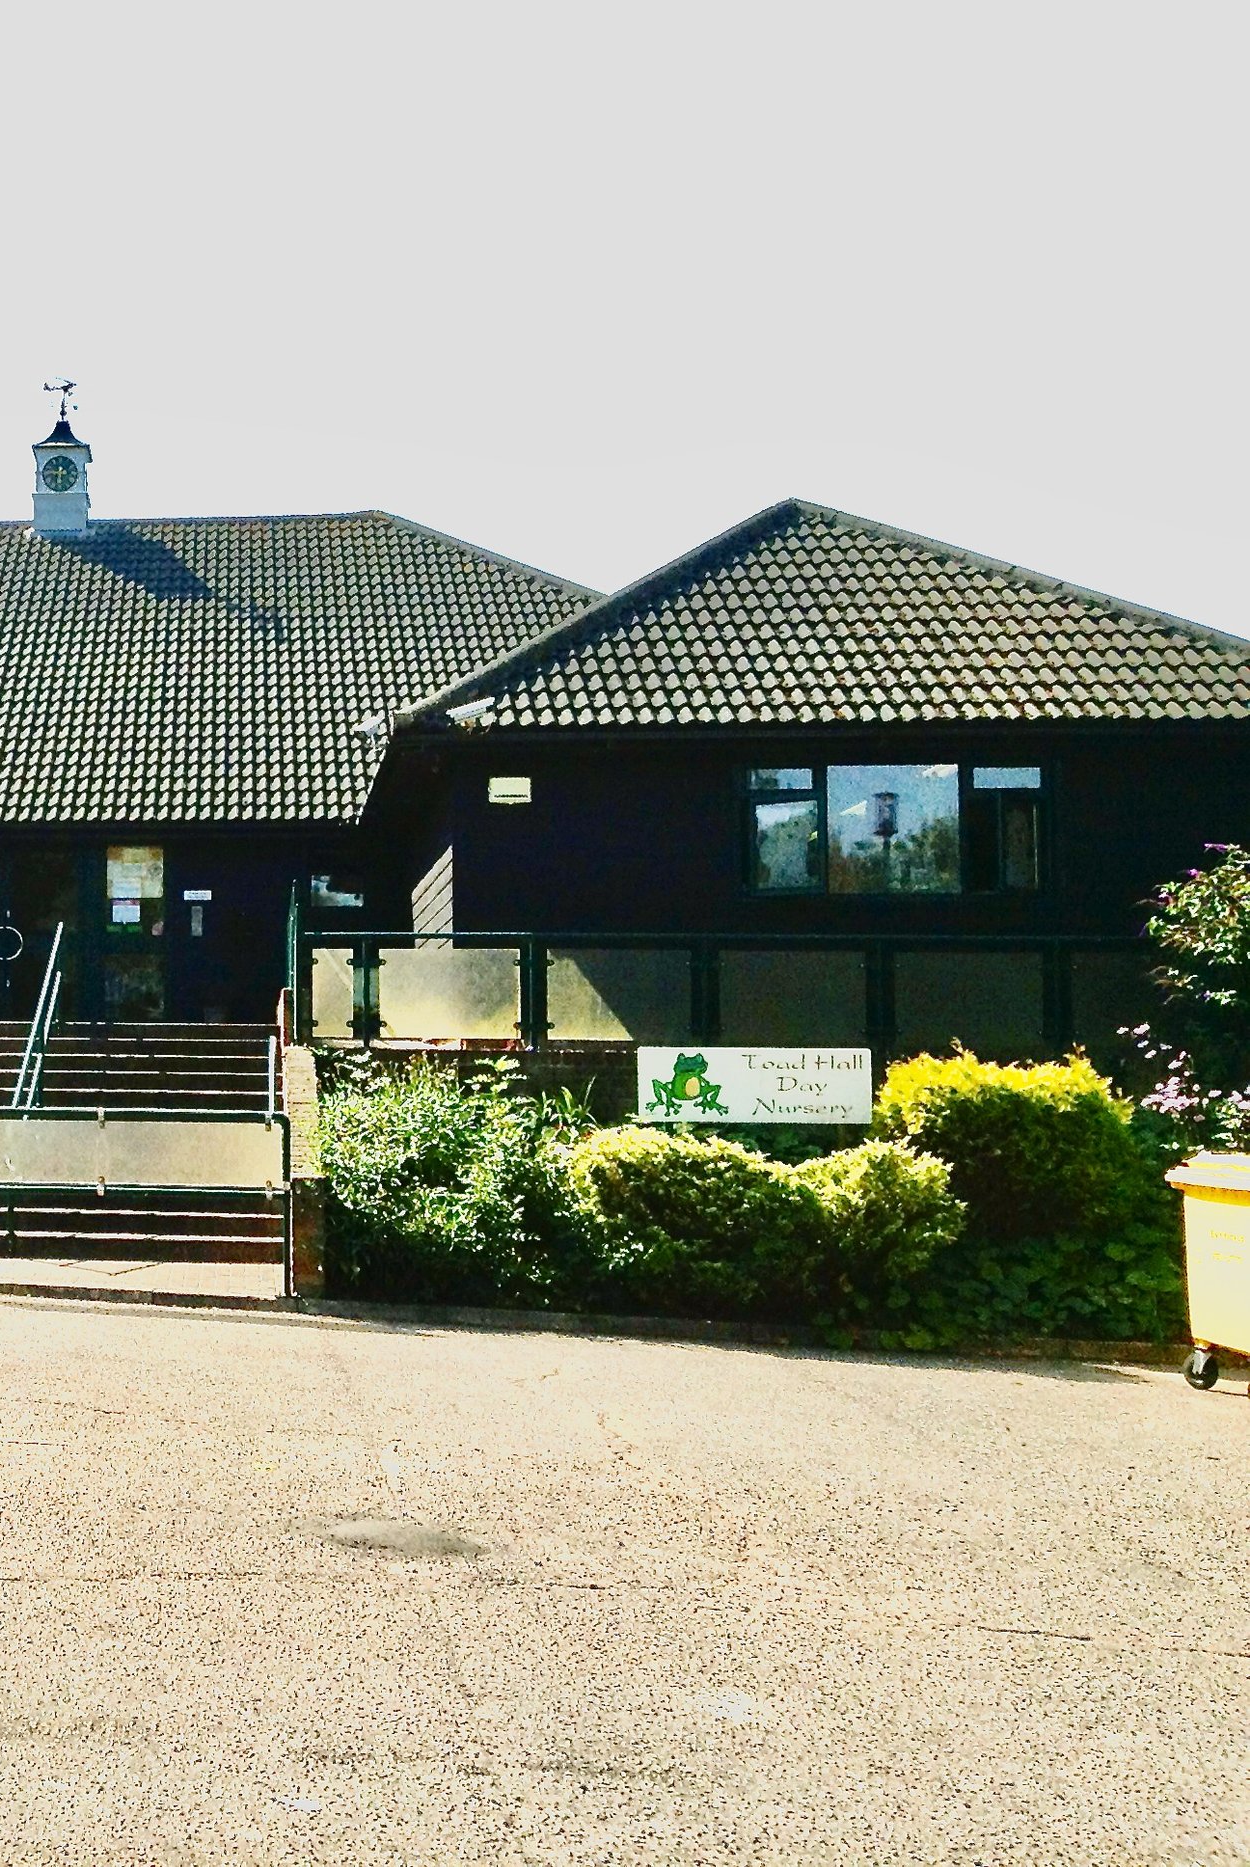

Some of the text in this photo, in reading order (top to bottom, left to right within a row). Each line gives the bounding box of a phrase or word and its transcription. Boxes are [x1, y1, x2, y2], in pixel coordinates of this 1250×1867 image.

[741, 1053, 862, 1070] Toad Hall
[776, 1076, 828, 1096] Day
[752, 1097, 853, 1119] Nursery
